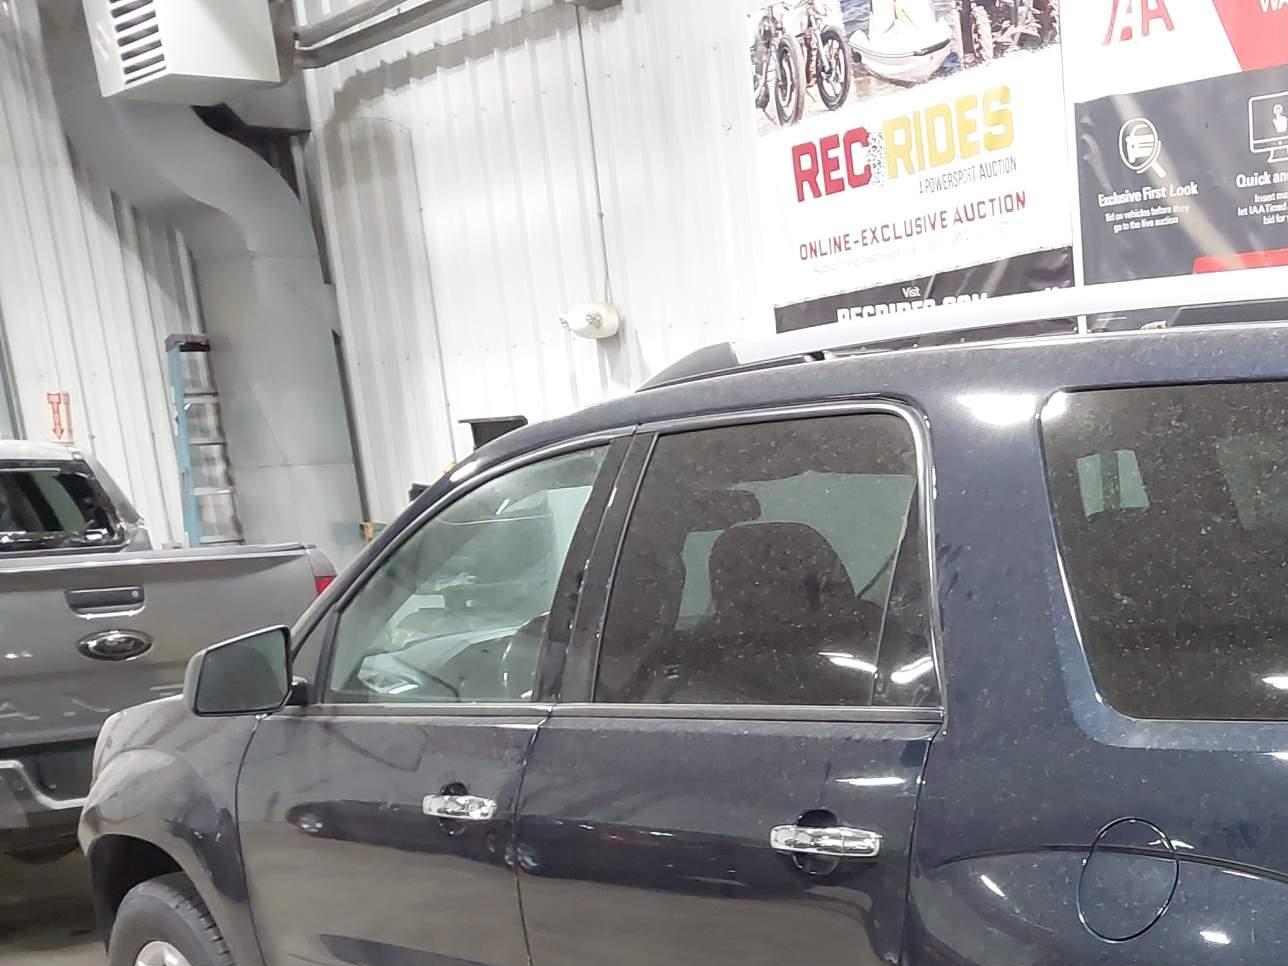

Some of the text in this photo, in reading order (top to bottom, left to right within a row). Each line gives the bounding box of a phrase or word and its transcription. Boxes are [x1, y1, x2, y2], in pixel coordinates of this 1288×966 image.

[792, 86, 1014, 202] REC RIDES
[980, 155, 1017, 180] AUCTION
[1236, 171, 1272, 188] Quick
[1098, 181, 1199, 207] Exclusive First Look
[799, 210, 948, 261] ONLINE-EXCLUSIVE
[953, 191, 1026, 225] AUCTION
[1275, 213, 1286, 223] for
